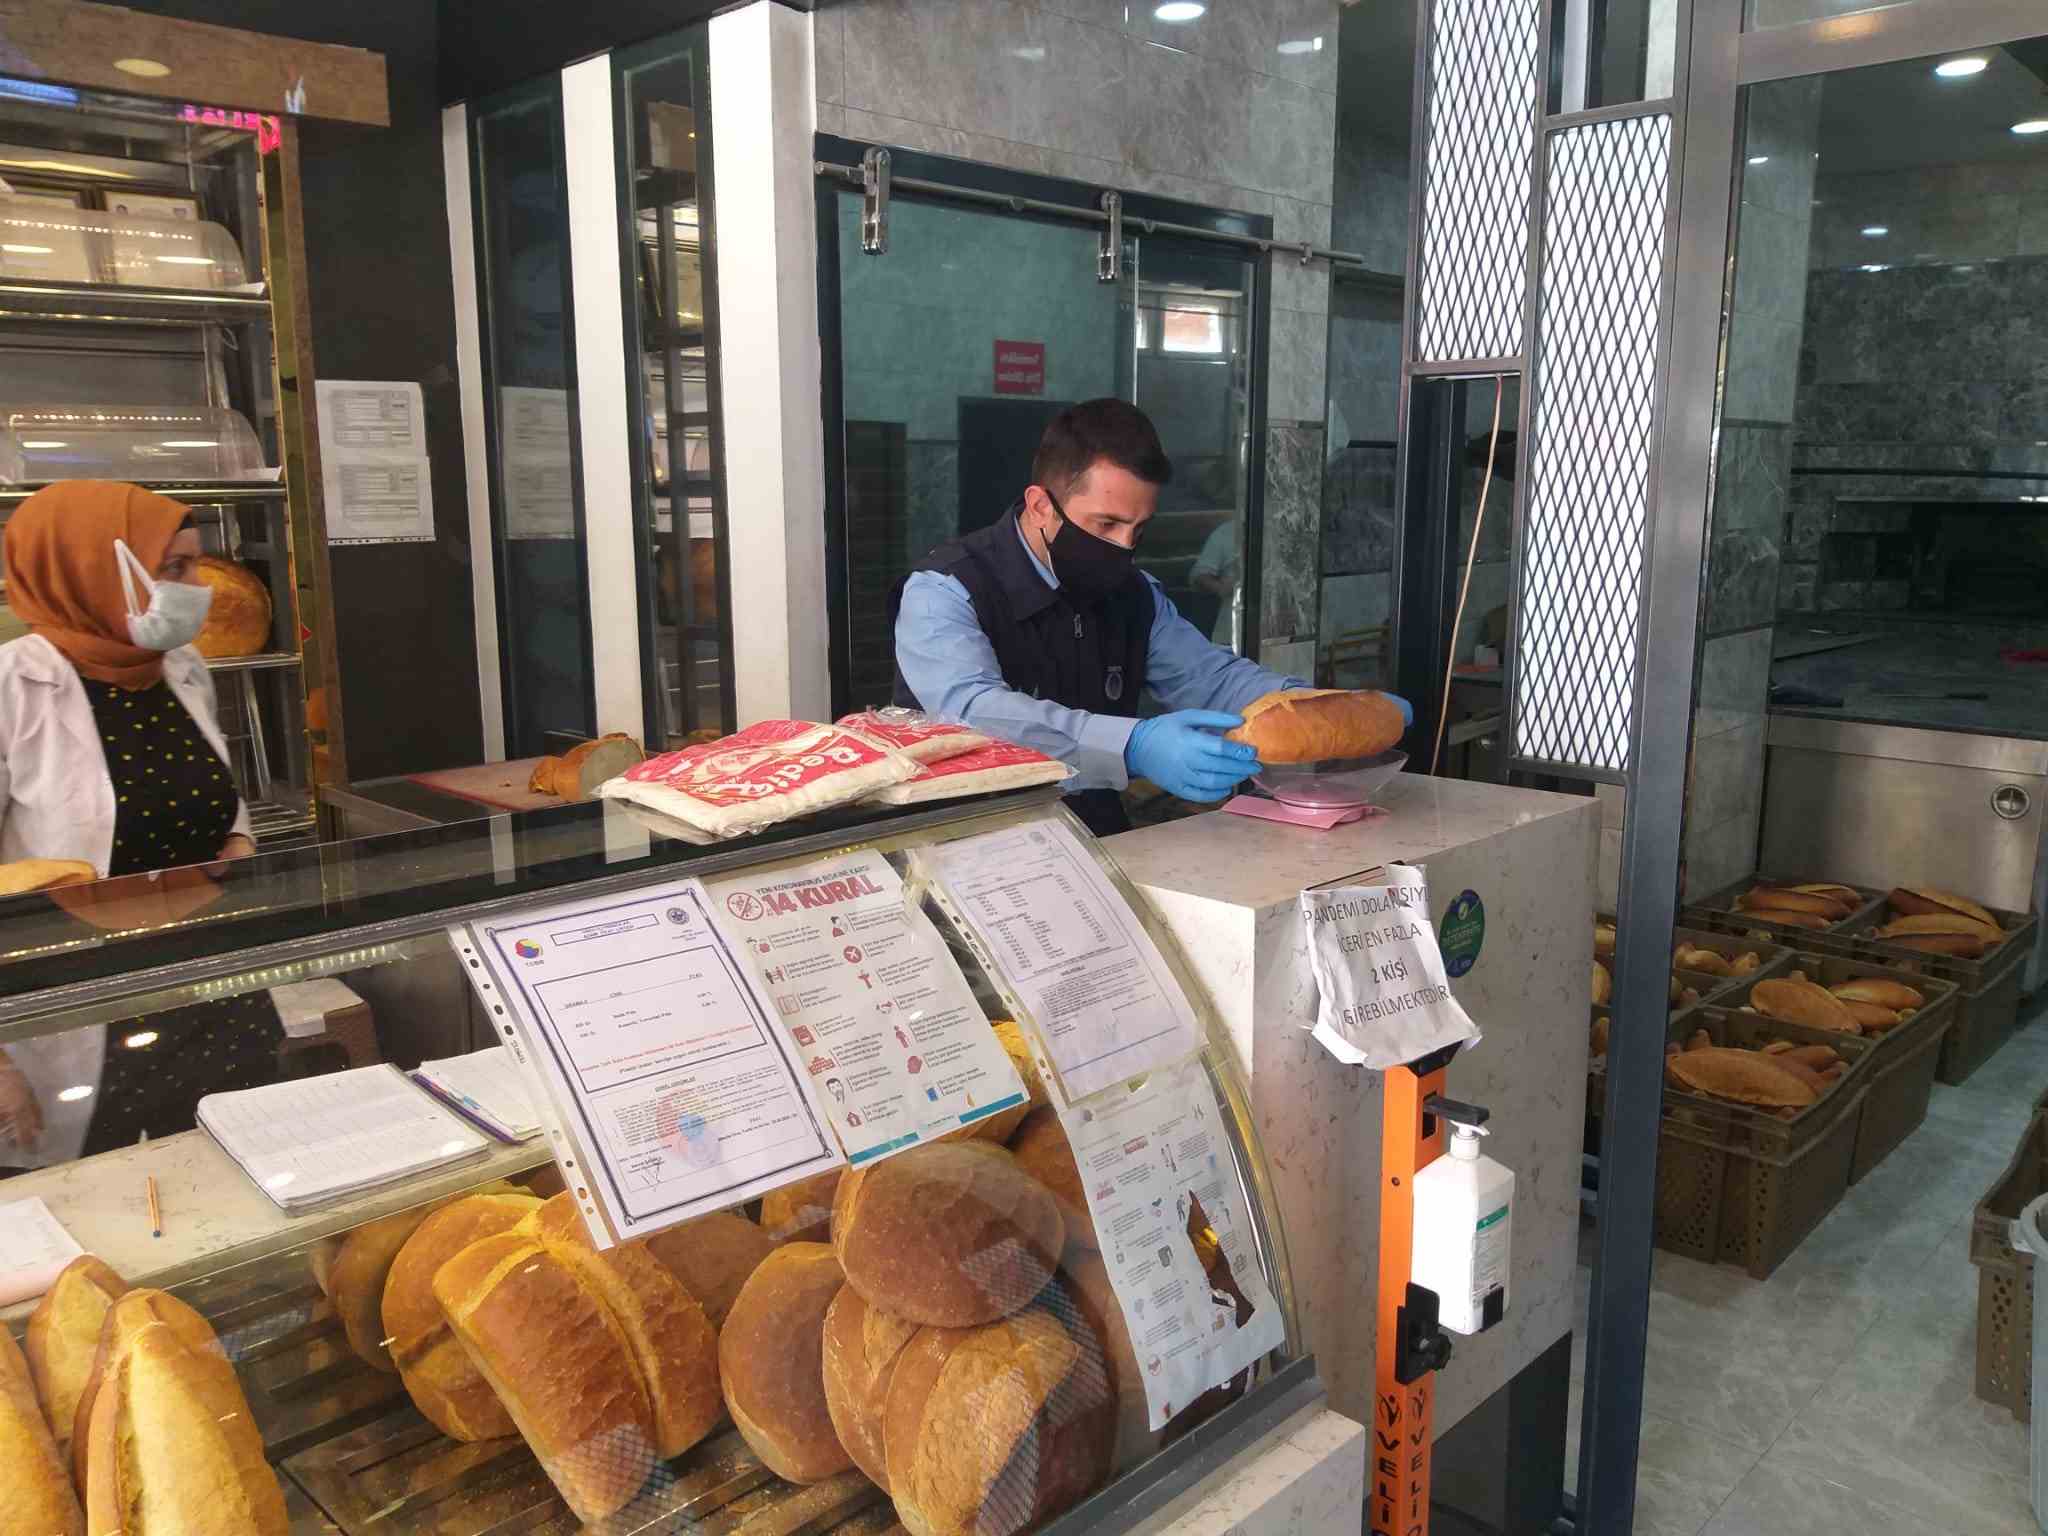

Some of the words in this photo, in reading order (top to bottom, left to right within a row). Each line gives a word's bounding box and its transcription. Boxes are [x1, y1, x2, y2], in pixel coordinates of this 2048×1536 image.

[761, 891, 798, 916] 14
[793, 873, 885, 909] KURAL
[1364, 931, 1384, 948] EN
[1384, 922, 1423, 941] FAZLA
[1370, 967, 1380, 984] 2
[1381, 957, 1409, 981] KİŞİ
